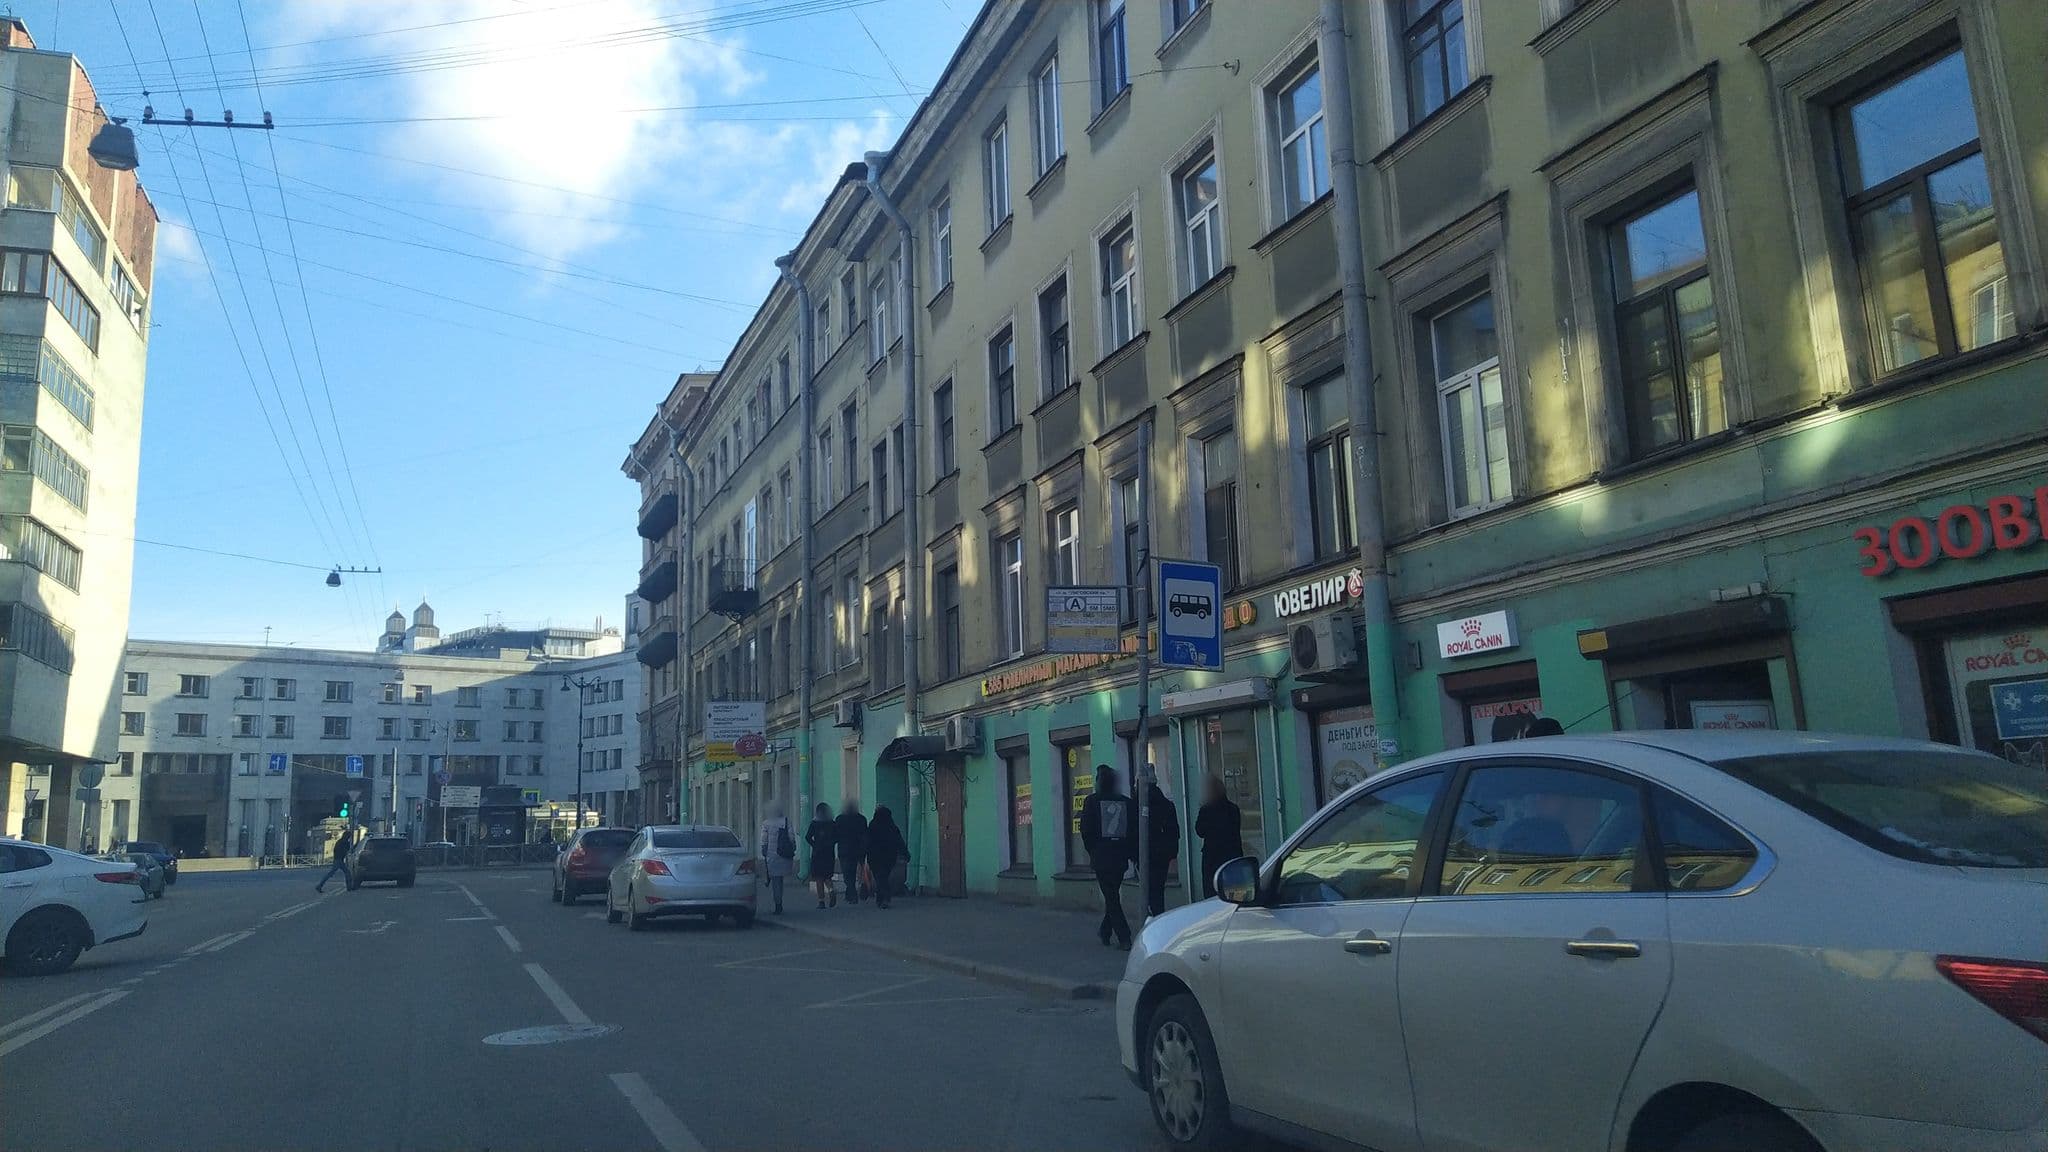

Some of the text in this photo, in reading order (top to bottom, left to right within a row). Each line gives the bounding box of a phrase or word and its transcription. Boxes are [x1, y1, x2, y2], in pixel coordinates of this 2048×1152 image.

[1274, 576, 1346, 618] ЮВЕЛИР
[1447, 634, 1503, 655] ROYAL CANIN
[1965, 652, 2019, 672] ROYAL
[1328, 727, 1362, 744] ДЕНЬГИ
